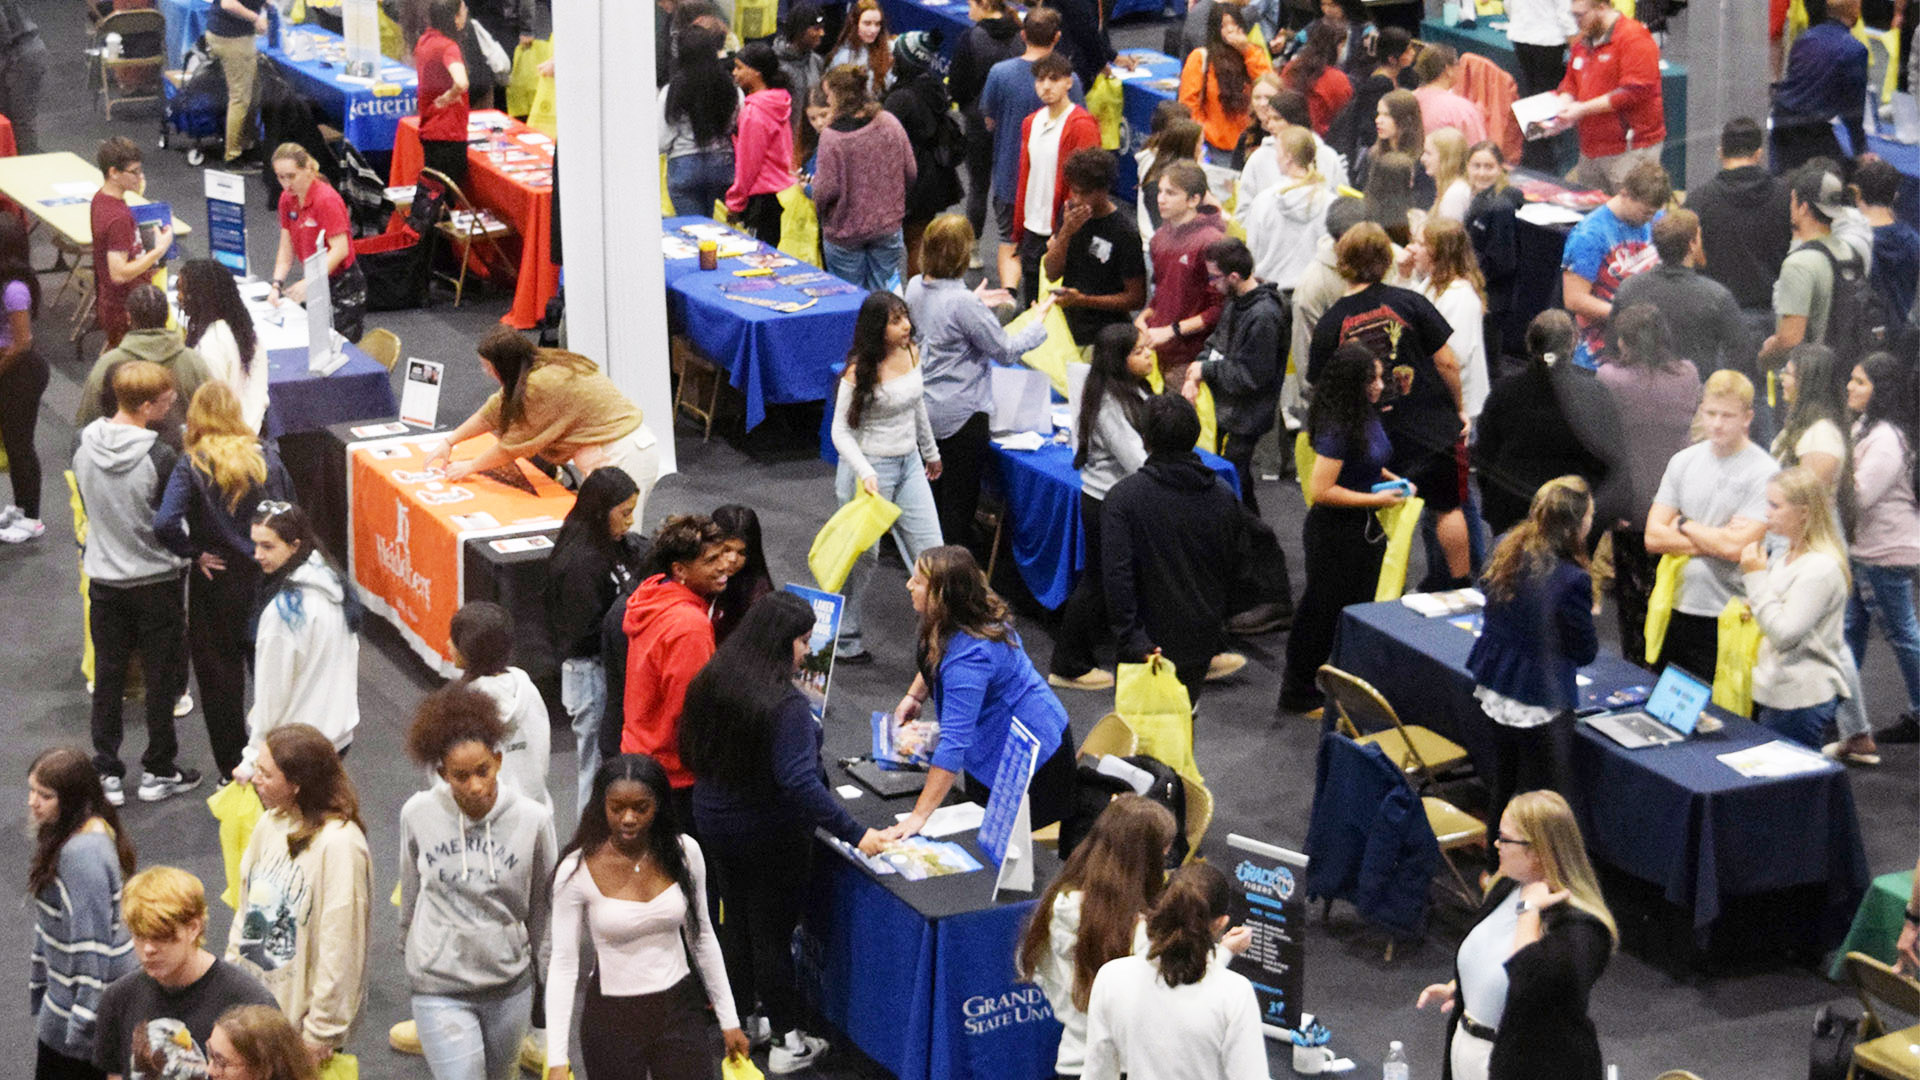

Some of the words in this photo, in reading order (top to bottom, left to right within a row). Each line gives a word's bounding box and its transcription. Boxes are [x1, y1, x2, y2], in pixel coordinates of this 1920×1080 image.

[425, 837, 519, 870] AMERICAN
[962, 988, 1041, 1018] GRAND
[964, 1011, 1013, 1035] STATE
